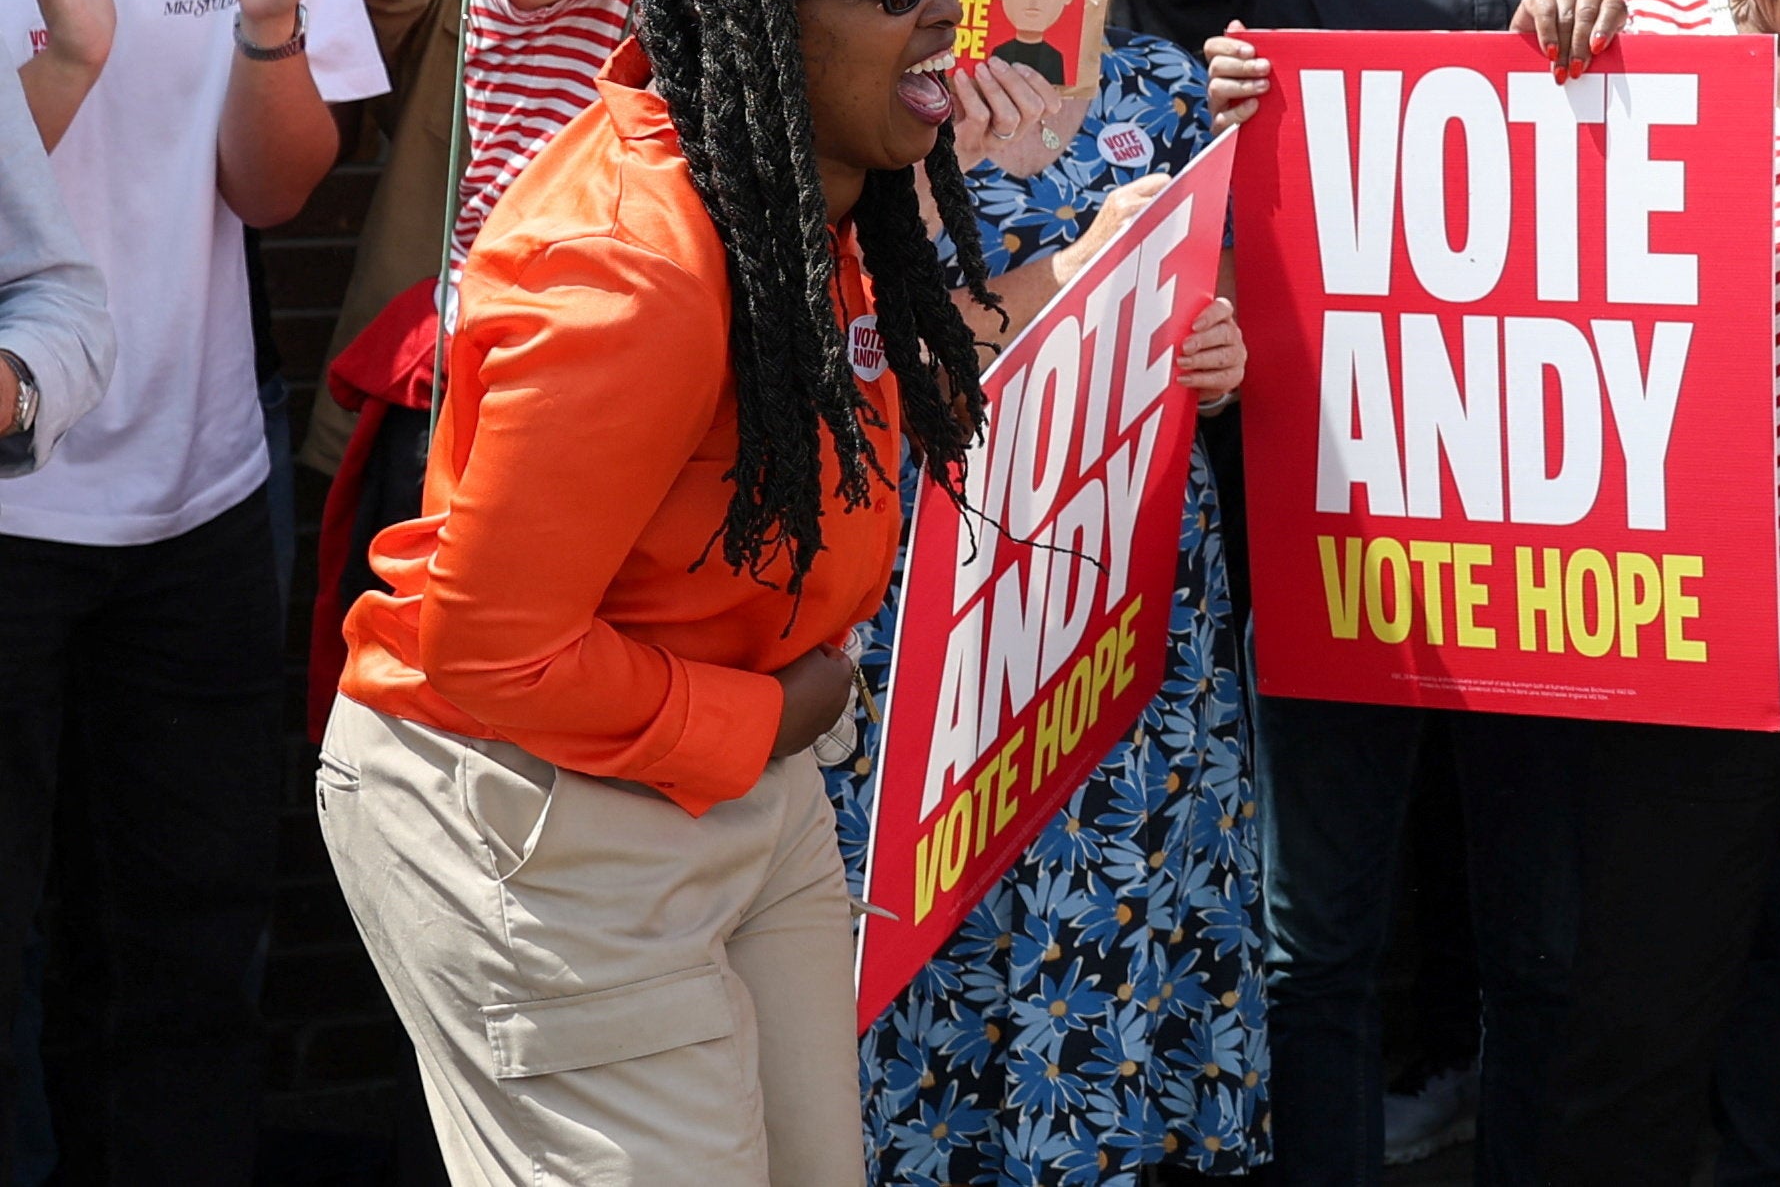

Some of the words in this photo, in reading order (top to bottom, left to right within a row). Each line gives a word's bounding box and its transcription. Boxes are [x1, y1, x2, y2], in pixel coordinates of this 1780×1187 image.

[29, 29, 48, 46] VO
[954, 28, 989, 60] PE
[1103, 129, 1141, 150] VOTE
[1113, 143, 1147, 162] ANDY
[1299, 66, 1699, 306] VOTE
[853, 347, 882, 369] ANDY
[953, 193, 1193, 616] VOTE
[1315, 310, 1694, 531] ANDY
[919, 404, 1164, 822] ANDY
[1317, 535, 1496, 649] VOTE
[1515, 545, 1707, 663] HOPE
[914, 725, 1024, 926] VOTE
[1030, 593, 1142, 795] HOPE
